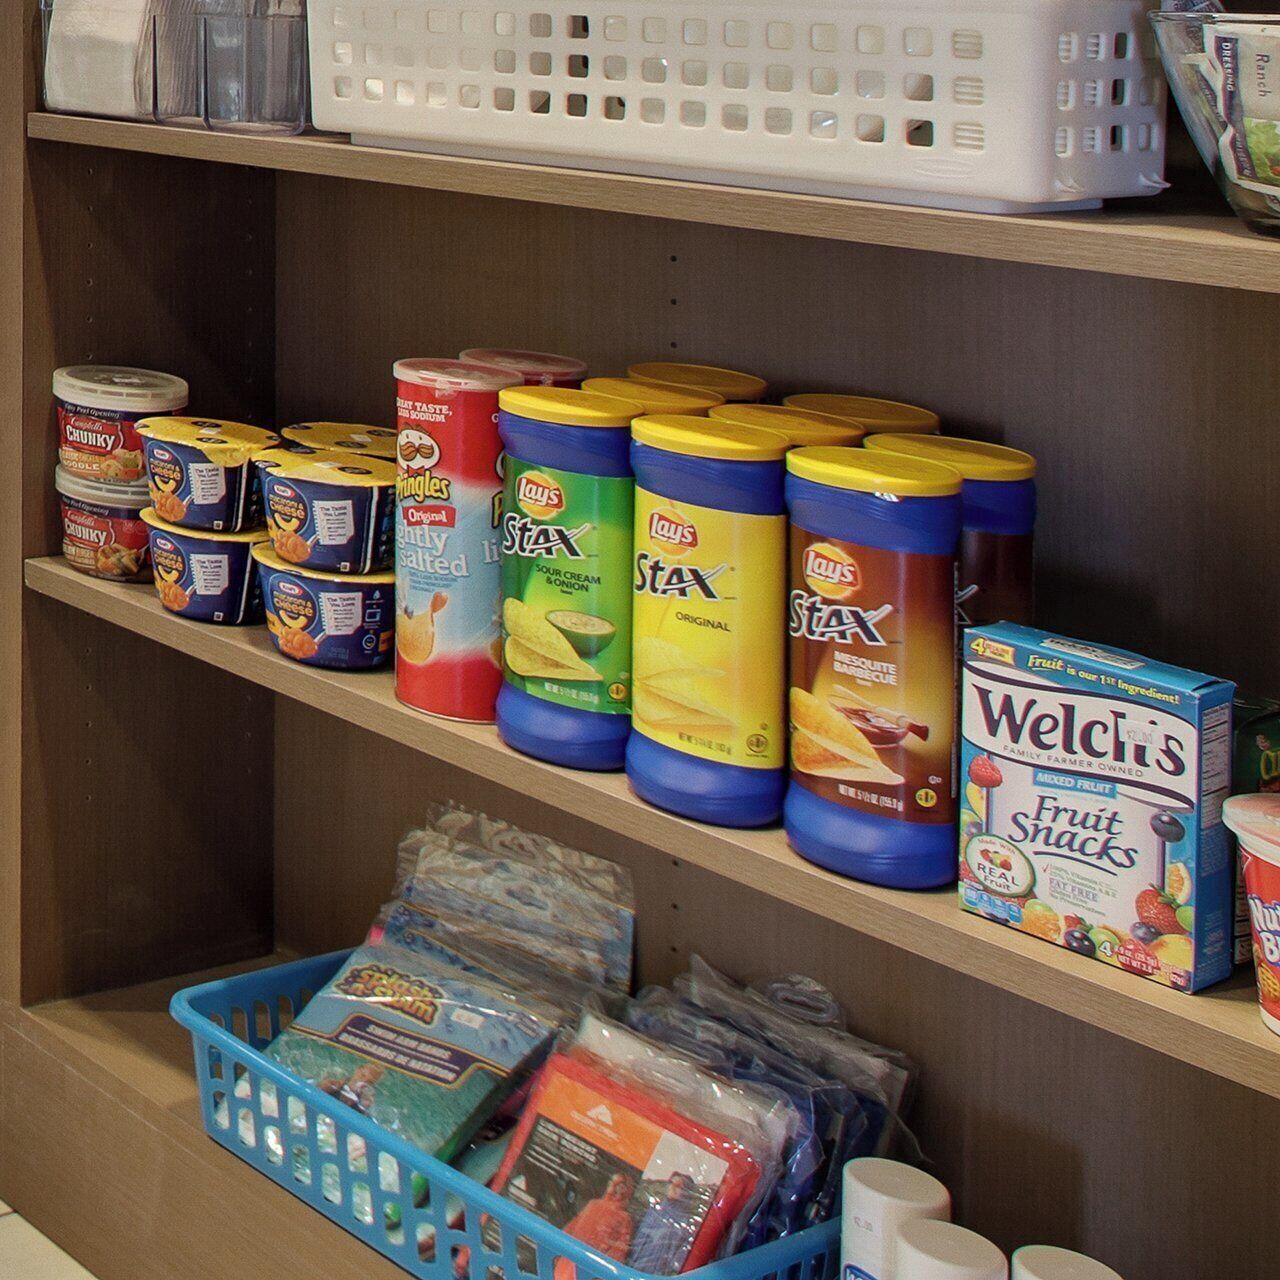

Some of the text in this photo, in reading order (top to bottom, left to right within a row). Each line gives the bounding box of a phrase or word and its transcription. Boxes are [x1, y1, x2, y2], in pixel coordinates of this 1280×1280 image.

[1255, 52, 1271, 99] Ranch
[410, 409, 446, 423] SODIUM
[65, 424, 116, 451] CHUNKY
[518, 477, 561, 506] Lay's
[408, 508, 448, 524] Original
[64, 517, 108, 546] CHUNKY
[650, 520, 696, 546] Lay's
[400, 549, 470, 577] salted
[536, 564, 602, 585] SOUR CREAM
[805, 549, 857, 584] Lay's
[554, 577, 590, 593] ONION
[272, 597, 314, 617] Cheese
[675, 610, 732, 632] ORIGINAL
[833, 661, 899, 687] BARBECUE
[834, 650, 897, 675] MESQUITE
[1027, 654, 1063, 670] Fruit
[1067, 664, 1077, 676] is
[1078, 670, 1098, 682] our
[1117, 679, 1182, 706] Ingredient!
[1003, 744, 1144, 777] FAMILY FARMER OWNED
[1036, 771, 1114, 795] MIXED FRUIT
[1036, 794, 1123, 835] Fruit
[1008, 811, 1139, 869] Snacks
[977, 862, 1020, 887] REAL
[983, 874, 1012, 892] Fruit
[1050, 877, 1098, 902] FAT FREE
